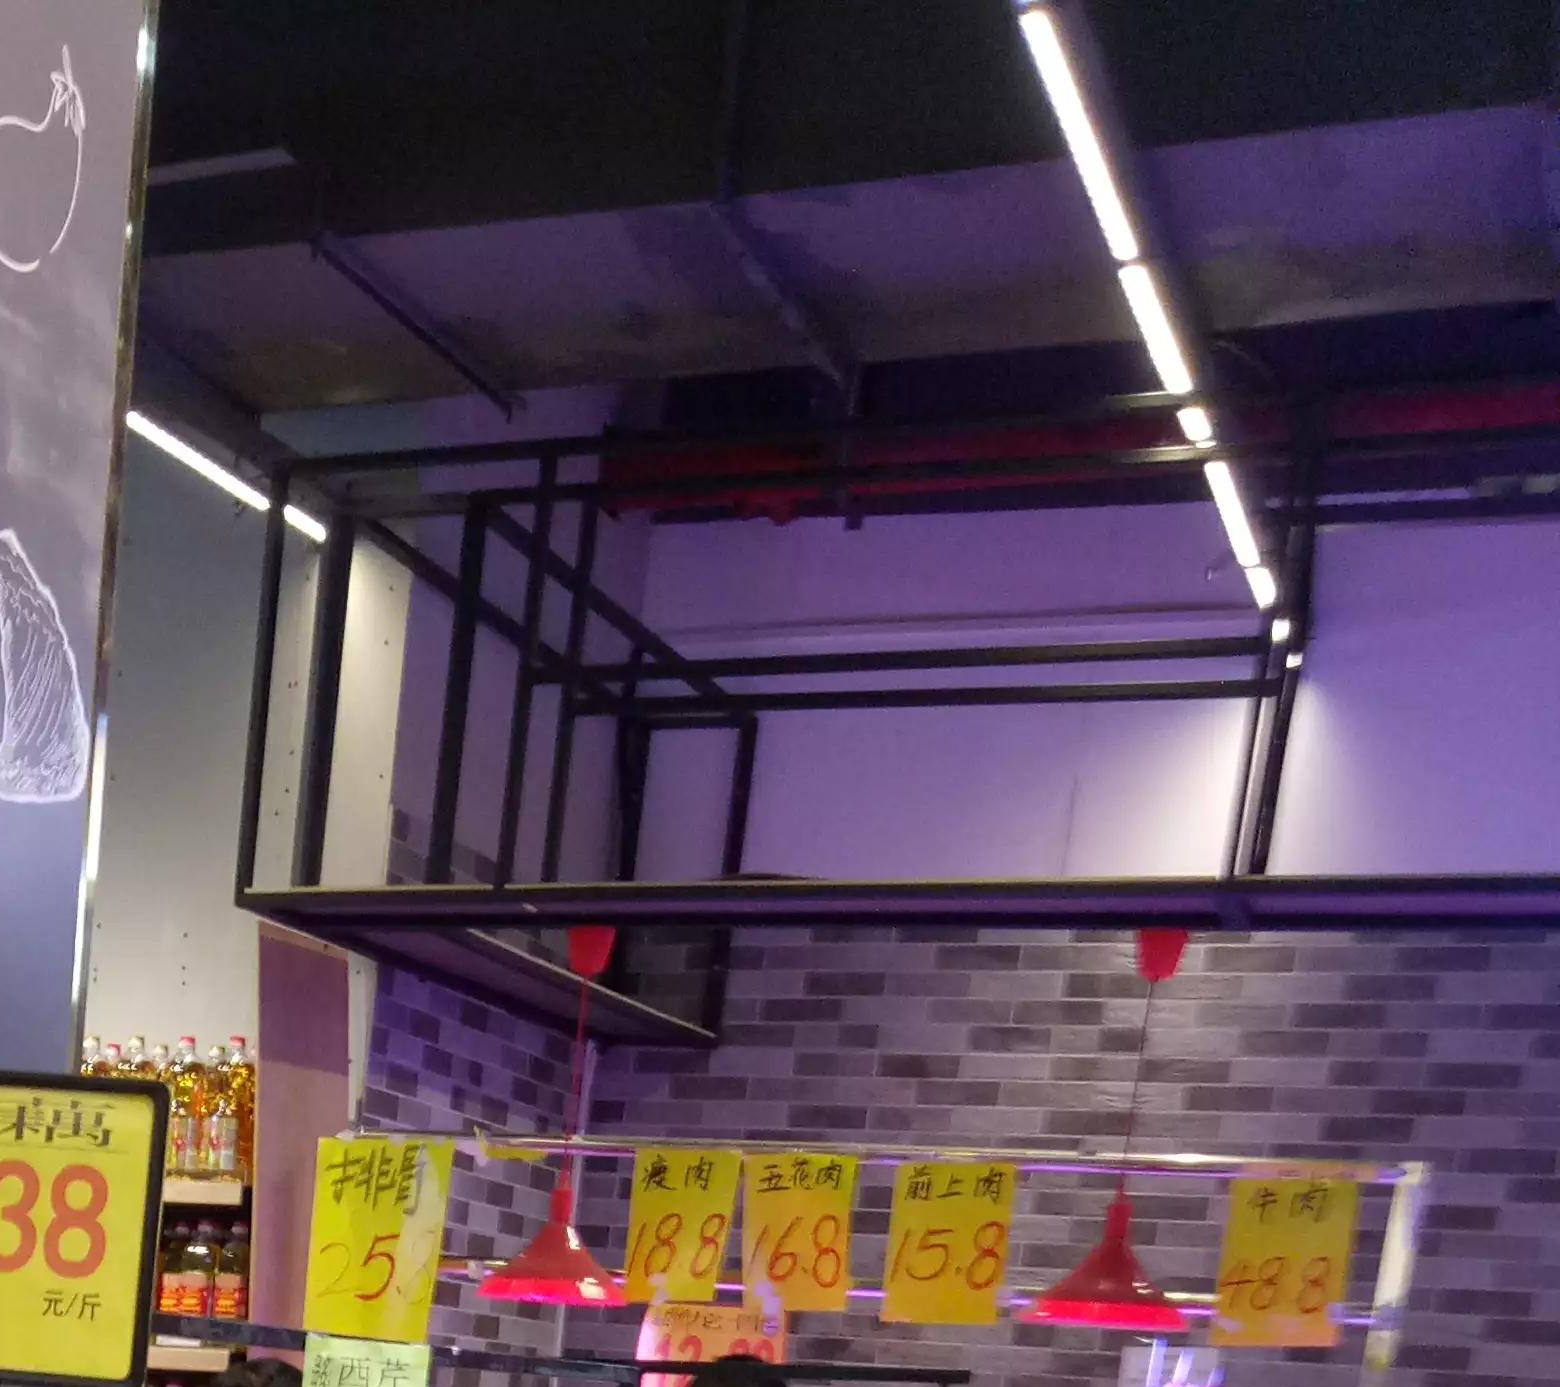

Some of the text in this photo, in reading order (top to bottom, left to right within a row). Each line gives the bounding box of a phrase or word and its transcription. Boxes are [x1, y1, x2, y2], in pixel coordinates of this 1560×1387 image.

[325, 1143, 428, 1216] 排骨
[642, 1153, 715, 1193] 瘦肉
[756, 1157, 843, 1194] 五花肉
[749, 1213, 842, 1289] 16.8
[890, 1220, 1007, 1291] 15.8
[42, 1289, 102, 1322] 元/斤
